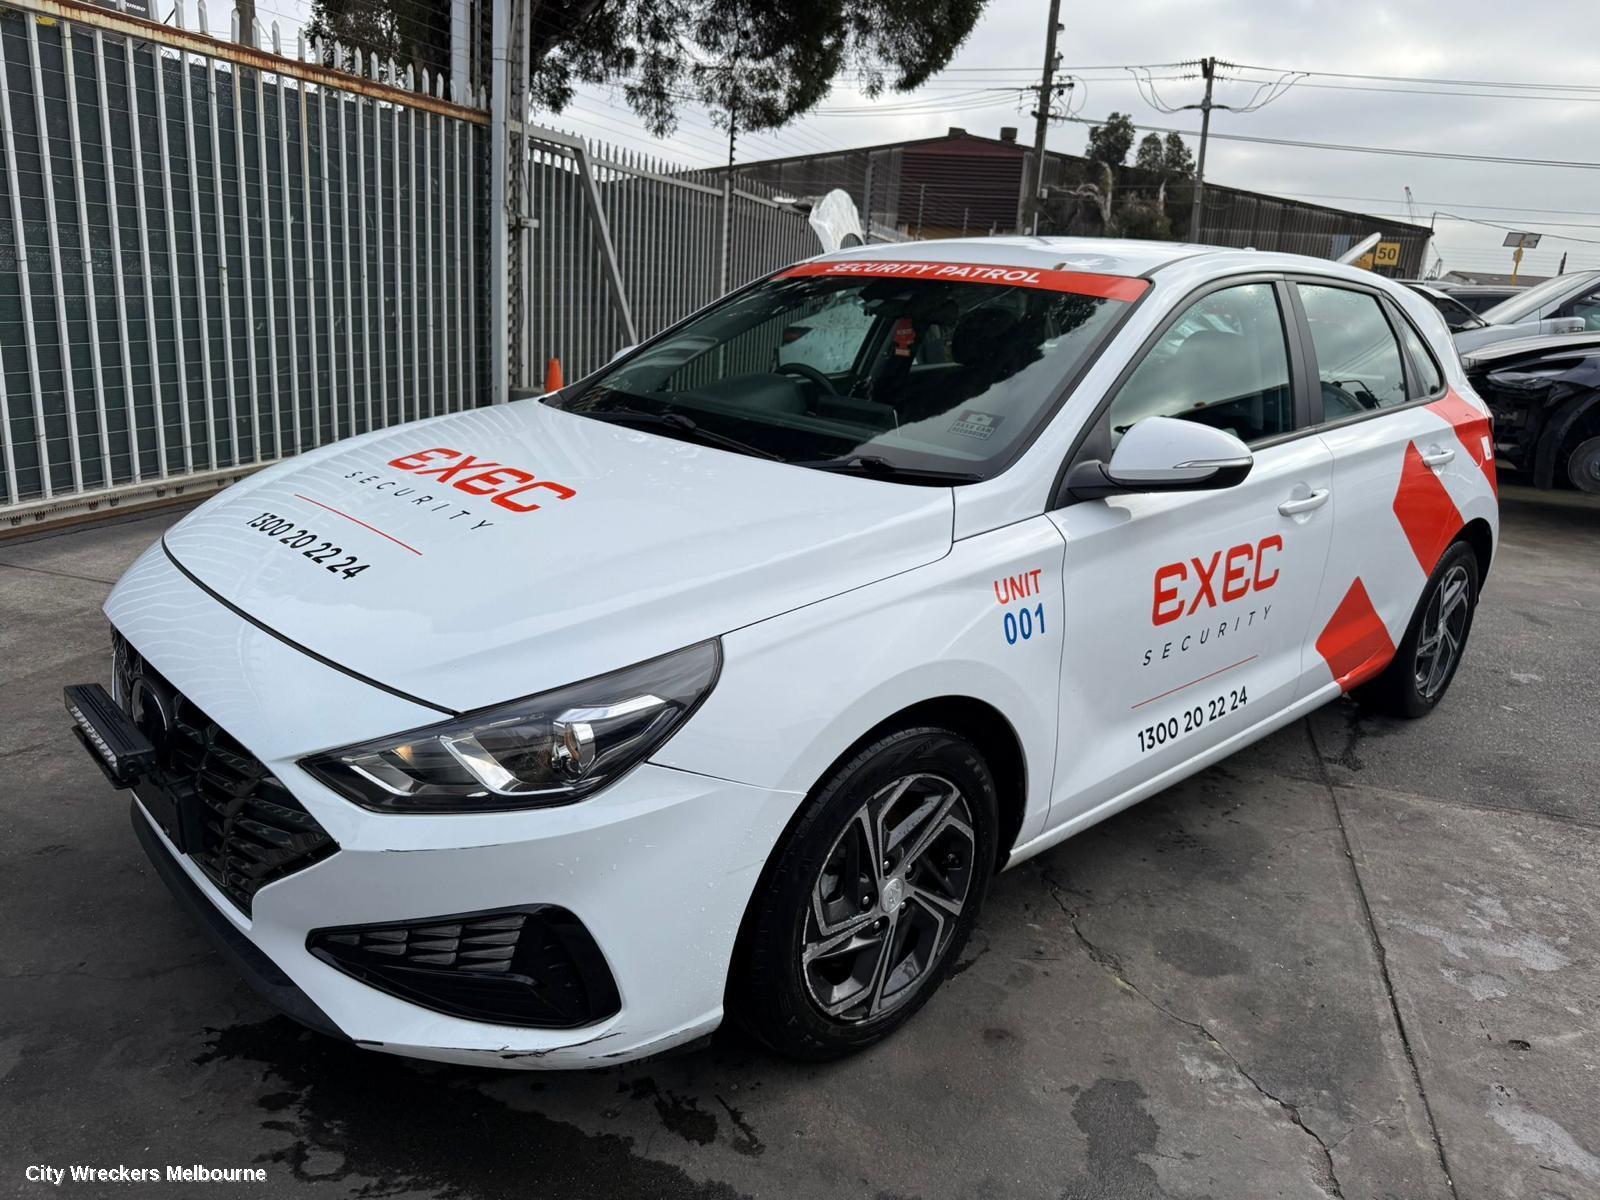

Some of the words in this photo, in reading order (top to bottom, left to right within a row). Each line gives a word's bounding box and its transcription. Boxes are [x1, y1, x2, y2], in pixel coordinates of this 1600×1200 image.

[826, 262, 937, 275] SECURITY
[935, 264, 1041, 285] PATROL
[1377, 247, 1397, 260] 50
[344, 471, 494, 531] SECURITY
[387, 447, 577, 513] EXEC
[246, 512, 287, 537] 1300
[279, 529, 318, 549] 20
[302, 542, 342, 564] 22
[326, 556, 370, 580] 24
[994, 568, 1041, 604] UNIT
[1152, 534, 1283, 627] EXEC
[1004, 602, 1045, 645] 001
[1142, 604, 1272, 666] SECURITY
[1137, 717, 1179, 752] 1300
[1184, 706, 1204, 733] 20
[1208, 696, 1226, 722] 22
[1230, 686, 1248, 711] 24
